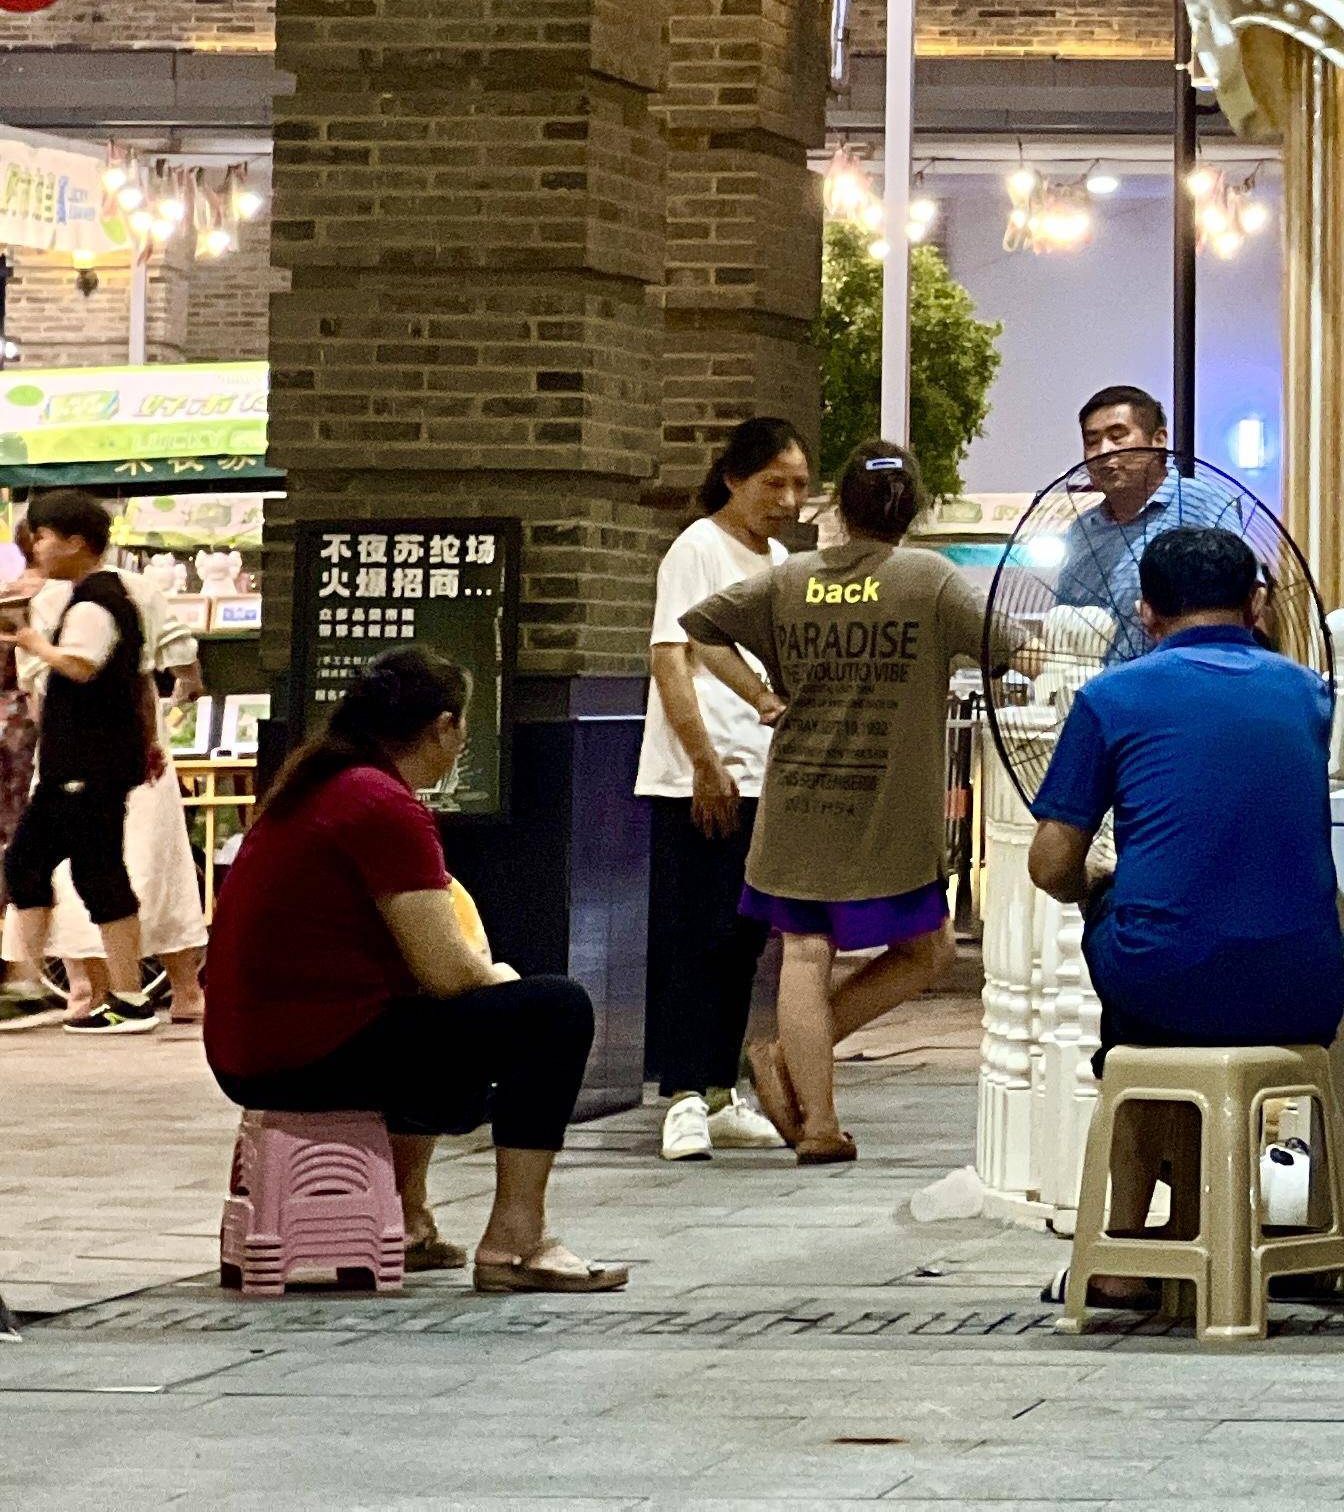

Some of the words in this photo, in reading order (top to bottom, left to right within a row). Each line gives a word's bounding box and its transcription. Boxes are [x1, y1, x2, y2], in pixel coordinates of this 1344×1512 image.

[320, 534, 495, 564] 不夜苏纶场
[806, 576, 880, 604] back
[775, 620, 920, 660] PARADISE
